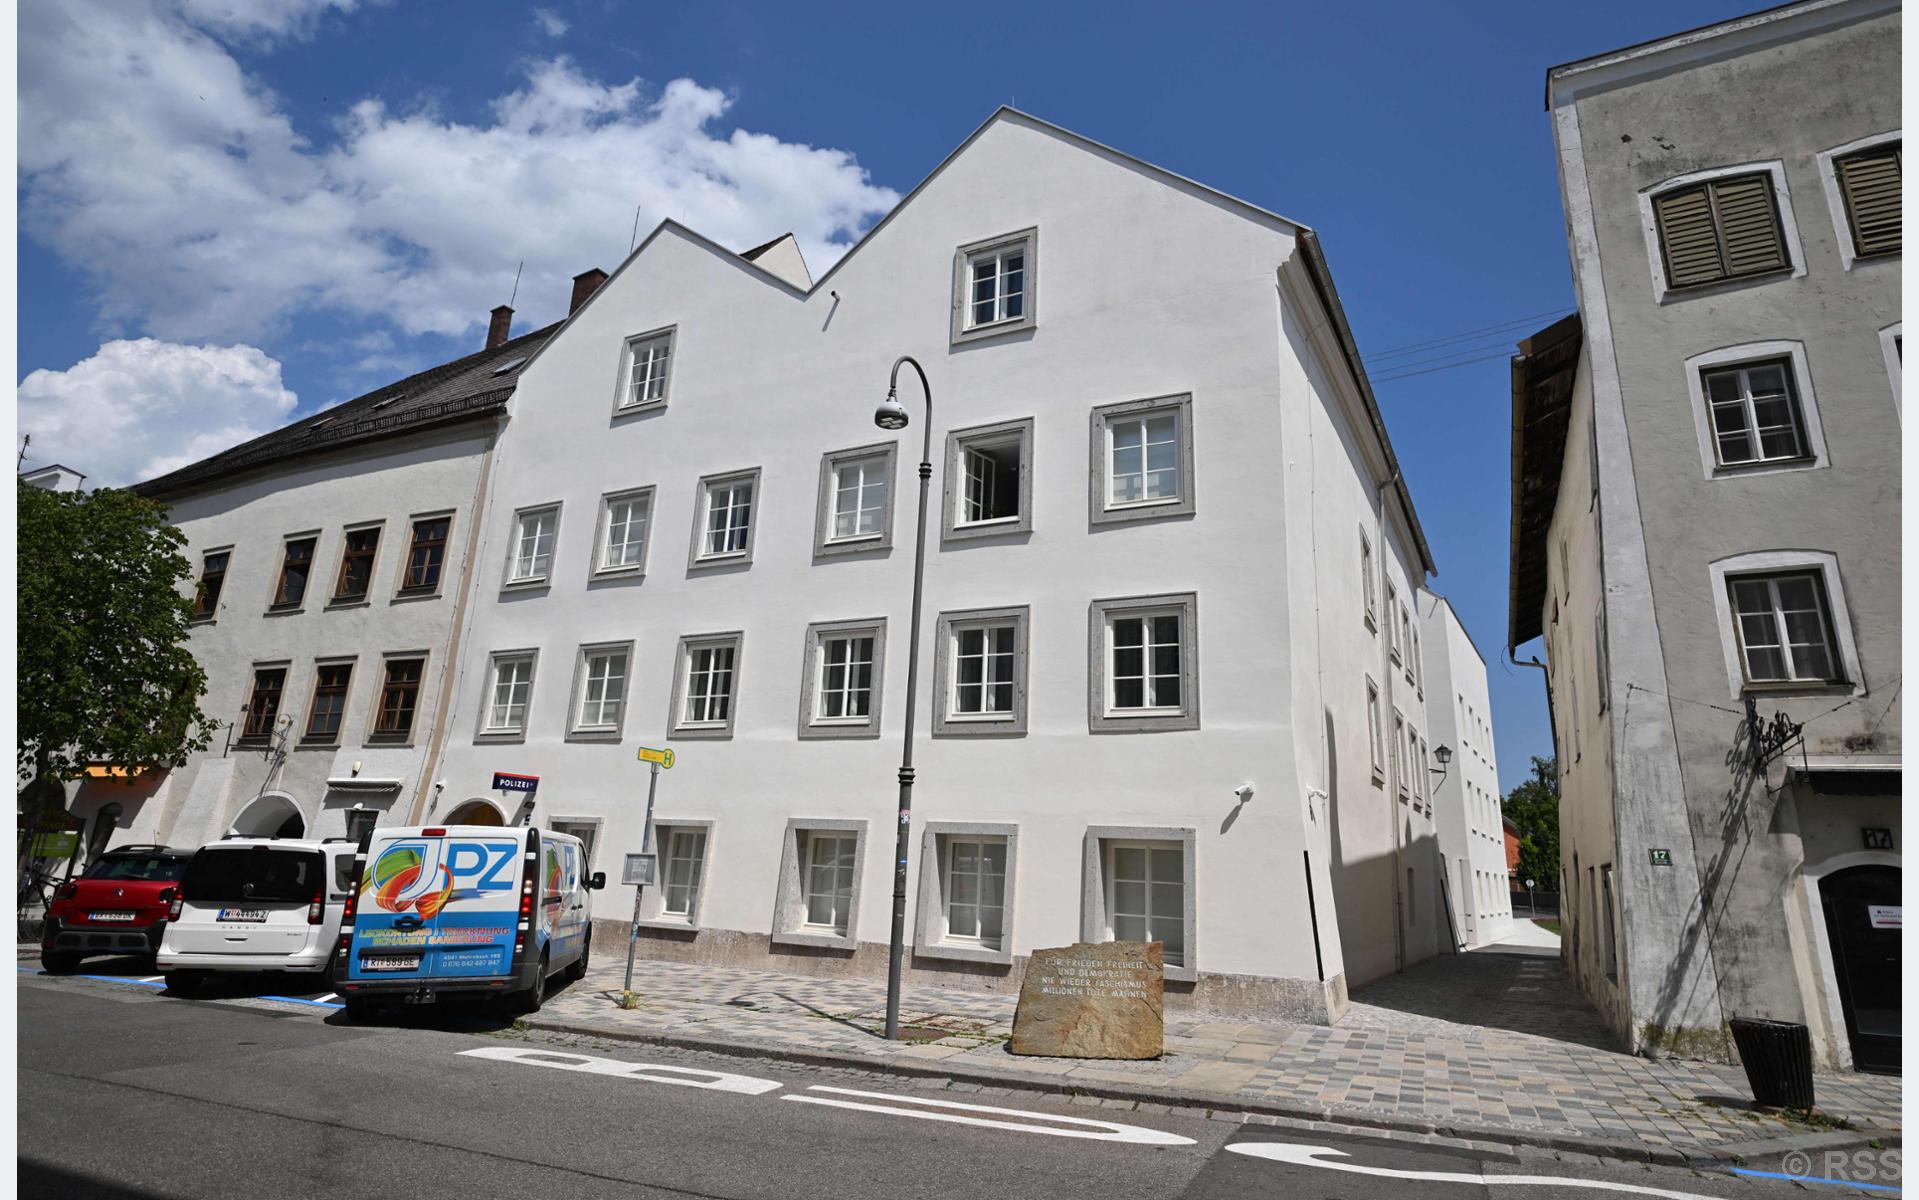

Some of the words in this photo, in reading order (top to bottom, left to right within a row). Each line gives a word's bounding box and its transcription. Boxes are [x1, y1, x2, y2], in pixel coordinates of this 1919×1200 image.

[499, 779, 530, 788] POLIZEI
[1652, 850, 1667, 859] 17
[1066, 958, 1103, 967] FRIEDEN
[1107, 960, 1143, 969] FREIHEIT
[1058, 967, 1075, 976] UND
[1078, 968, 1132, 978] DEMOKRATIE
[1041, 976, 1055, 985] NIE
[1060, 978, 1091, 987] WIEDER
[1096, 980, 1147, 989] FASCHISMUS
[1041, 987, 1083, 995] MILLIONEN
[1086, 988, 1106, 997] TOTE
[1111, 990, 1147, 998] MAHNEN
